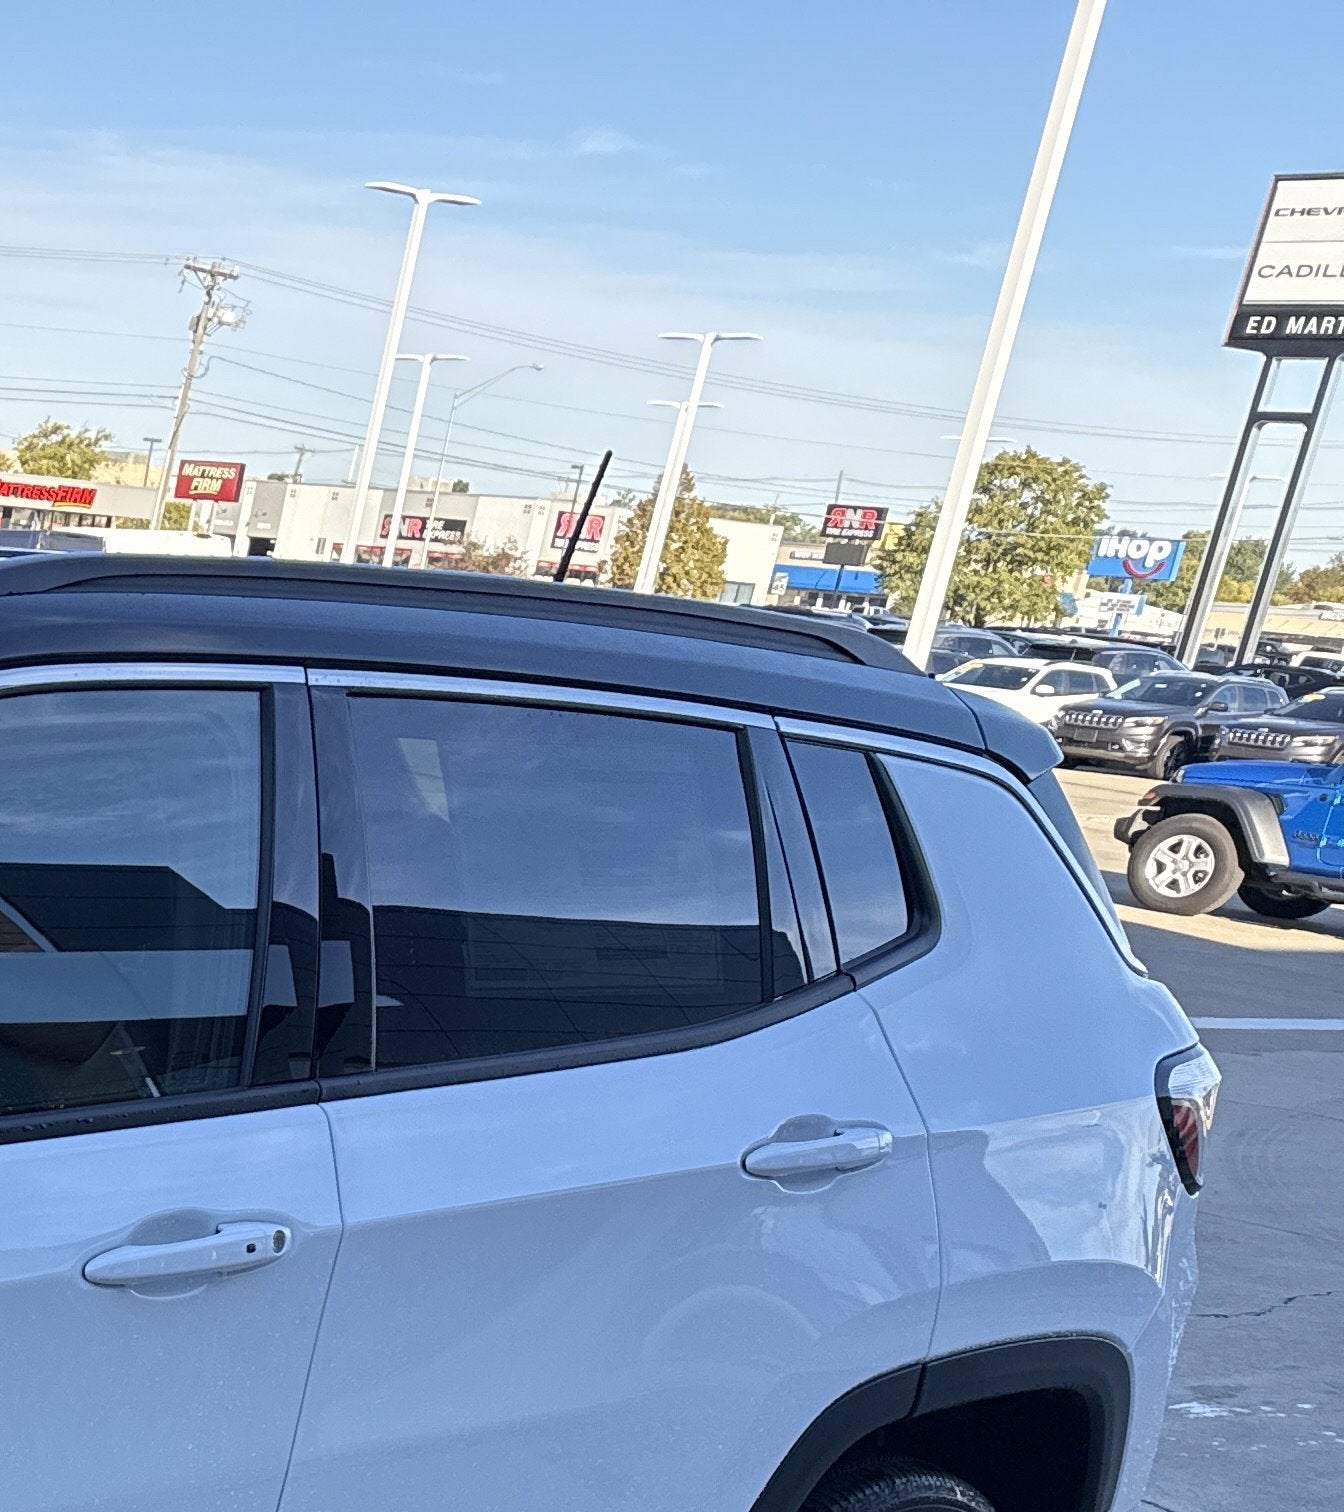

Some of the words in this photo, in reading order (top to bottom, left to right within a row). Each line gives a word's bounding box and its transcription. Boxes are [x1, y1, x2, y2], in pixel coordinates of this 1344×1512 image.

[1245, 315, 1277, 334] ED
[181, 463, 237, 480] MATTRESS
[190, 477, 223, 492] FIRM
[827, 507, 878, 530] RNR
